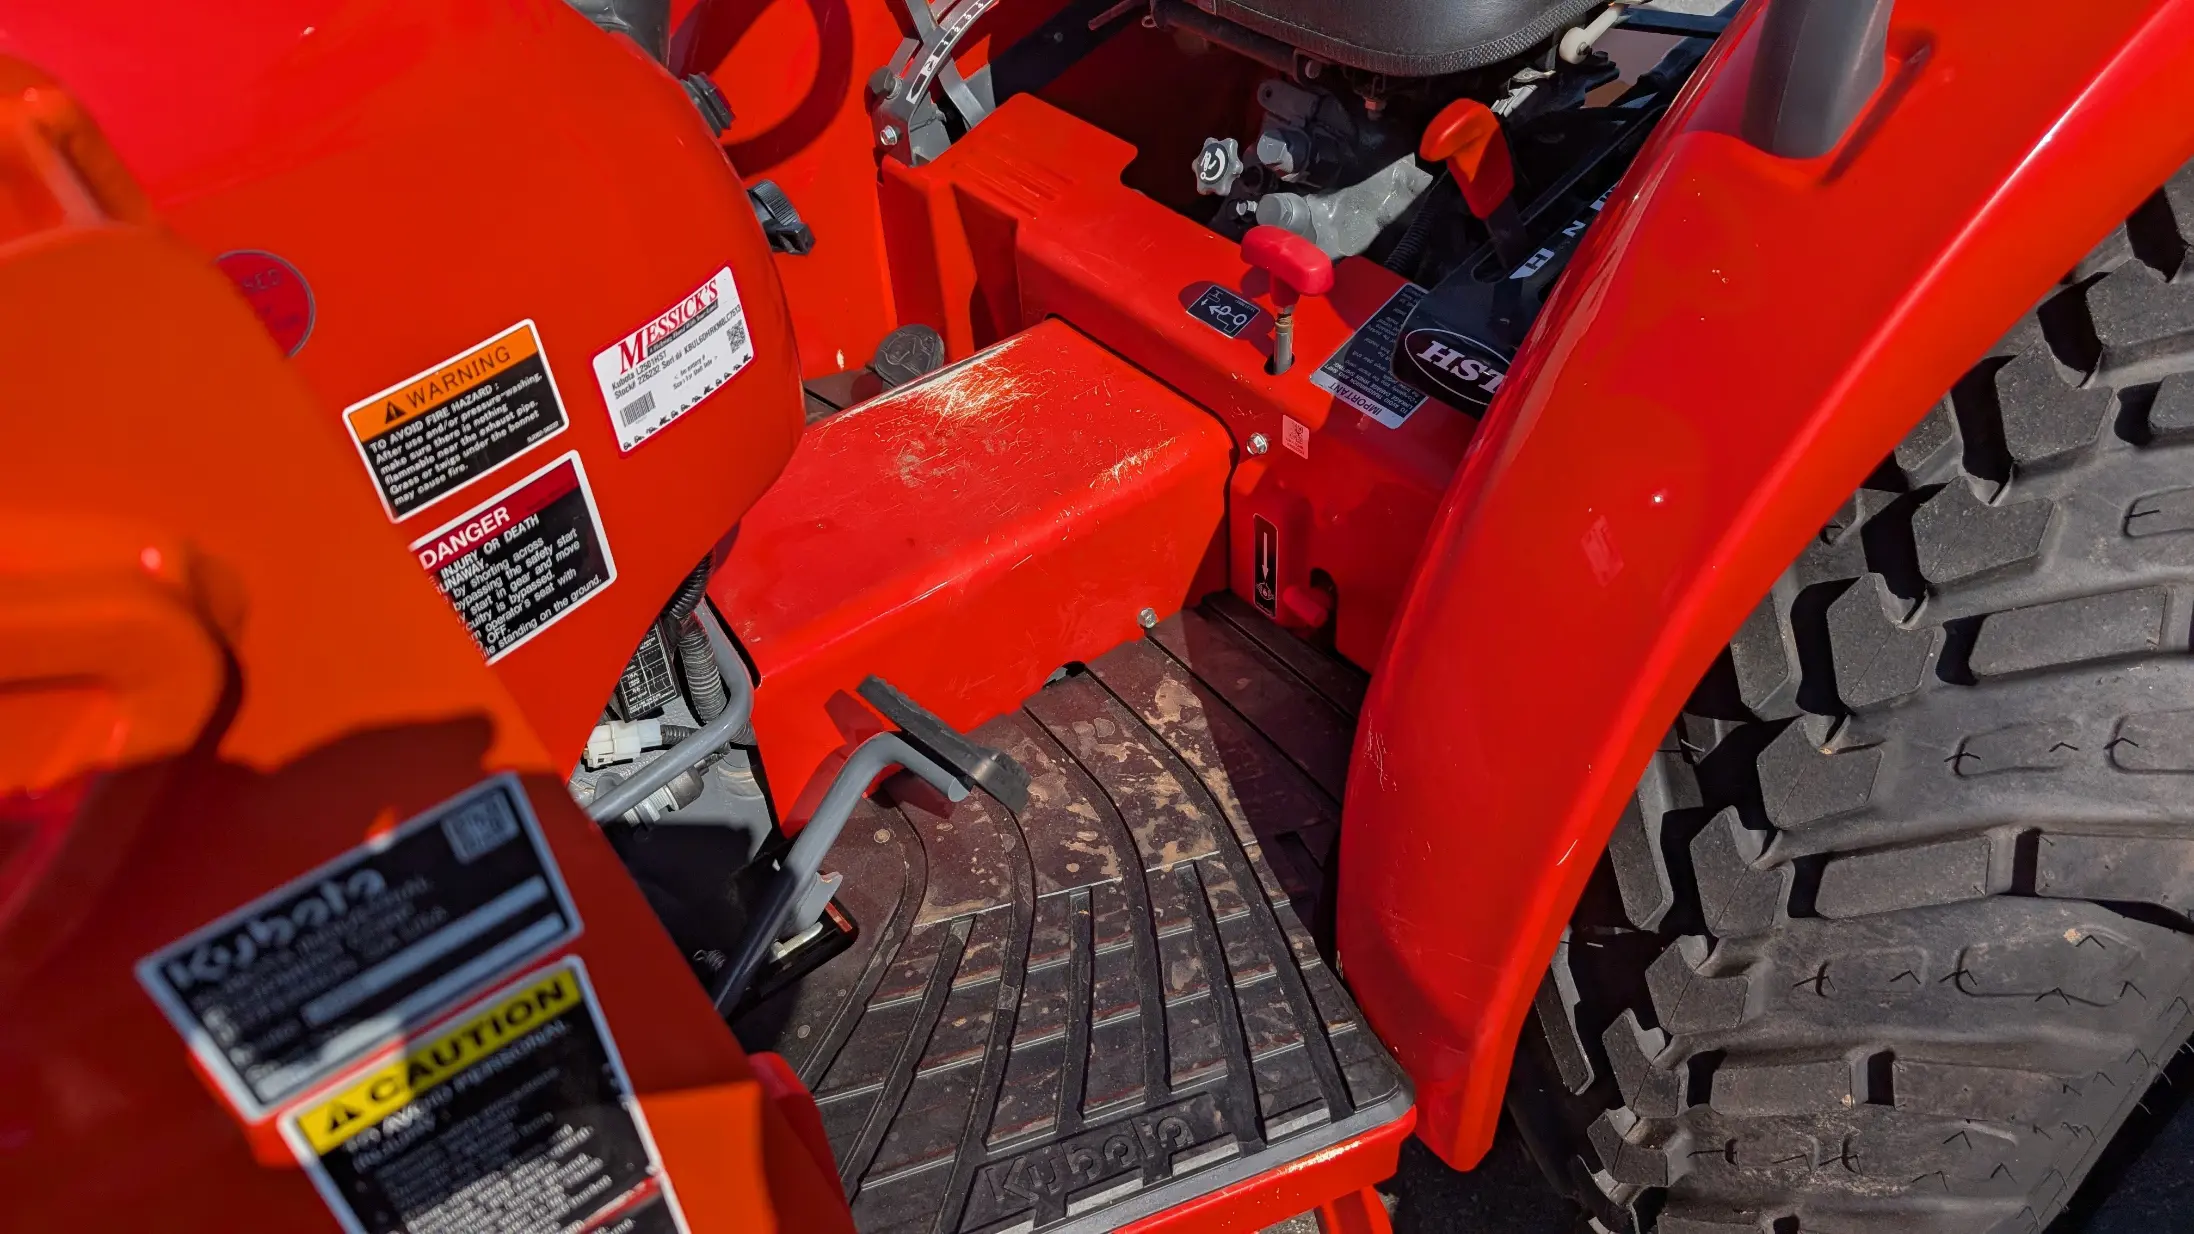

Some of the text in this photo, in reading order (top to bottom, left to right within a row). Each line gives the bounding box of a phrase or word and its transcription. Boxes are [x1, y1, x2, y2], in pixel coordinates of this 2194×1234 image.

[618, 278, 719, 374] MESSICK'S
[406, 346, 511, 409] WARNING
[612, 350, 667, 391] Kubota L2501HST
[637, 365, 660, 385] 226232
[1328, 382, 1383, 416] IMPORTANT
[369, 439, 387, 453] TO
[390, 421, 424, 445] AVOID
[425, 407, 450, 426] FIRE
[451, 385, 493, 413] HAZARD
[376, 445, 402, 465] After
[405, 435, 424, 450] use
[426, 416, 459, 440] and/or
[380, 403, 508, 475] make sure there is nothing
[385, 455, 435, 486] flammable
[437, 442, 458, 459] near
[460, 433, 477, 446] the
[479, 411, 515, 436] exhaust
[390, 476, 420, 495] Grass
[422, 468, 433, 479] or
[434, 454, 461, 472] twigs
[462, 438, 489, 458] under
[491, 429, 507, 442] the
[508, 410, 540, 433] bonnet
[394, 490, 415, 506] may
[417, 474, 446, 494] cause
[419, 507, 510, 570] DANGER
[441, 550, 478, 580] INJURY
[483, 538, 501, 555] OR
[504, 514, 539, 543] DEATH
[452, 537, 544, 598] by shorting across
[453, 576, 503, 612] bypassing
[505, 565, 522, 580] the
[525, 544, 553, 568] safety
[557, 528, 578, 548] start
[470, 595, 493, 615] start
[495, 585, 507, 599] in
[510, 572, 531, 592] gear
[535, 556, 553, 575] and
[556, 541, 580, 562] move
[485, 598, 531, 632] operator's
[534, 582, 555, 602] seat
[557, 568, 577, 586] with
[496, 601, 506, 613] is
[508, 569, 555, 605] bypassed.
[487, 624, 510, 644] OFF.
[498, 618, 538, 649] standing
[540, 609, 552, 621] on
[553, 597, 569, 612] the
[570, 574, 602, 602] ground.
[166, 868, 387, 992] Kubota
[369, 980, 567, 1104] CAUTION
[985, 1115, 1197, 1204] Kubota
